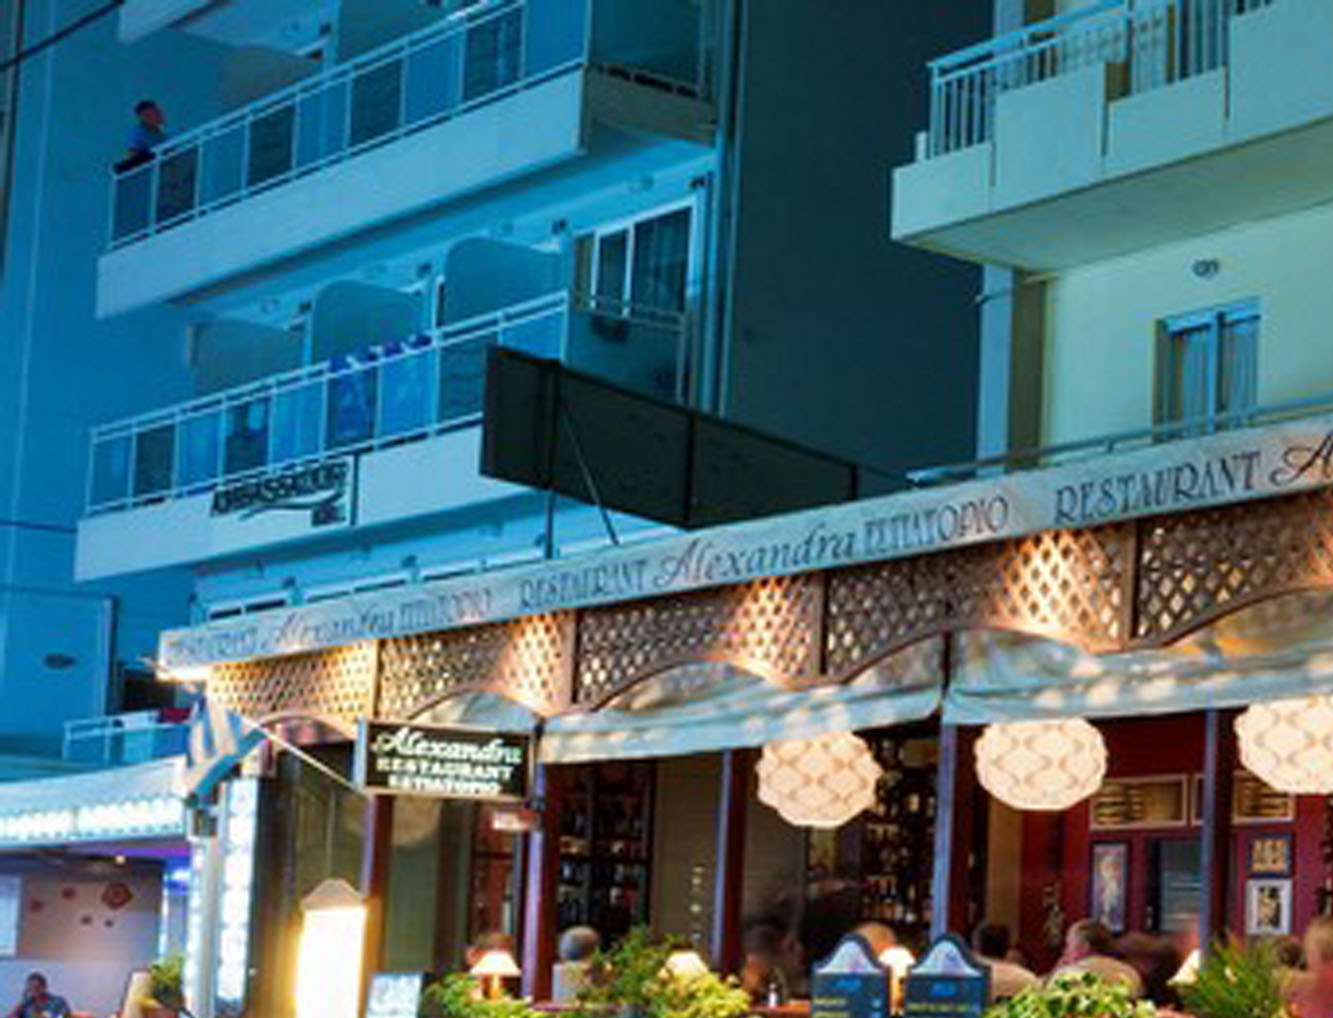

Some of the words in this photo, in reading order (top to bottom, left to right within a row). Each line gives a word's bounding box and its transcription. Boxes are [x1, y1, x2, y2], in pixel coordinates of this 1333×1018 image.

[1055, 451, 1261, 526] RESTAURANT
[653, 520, 856, 588] Alexandra
[371, 726, 523, 764] Alexandra
